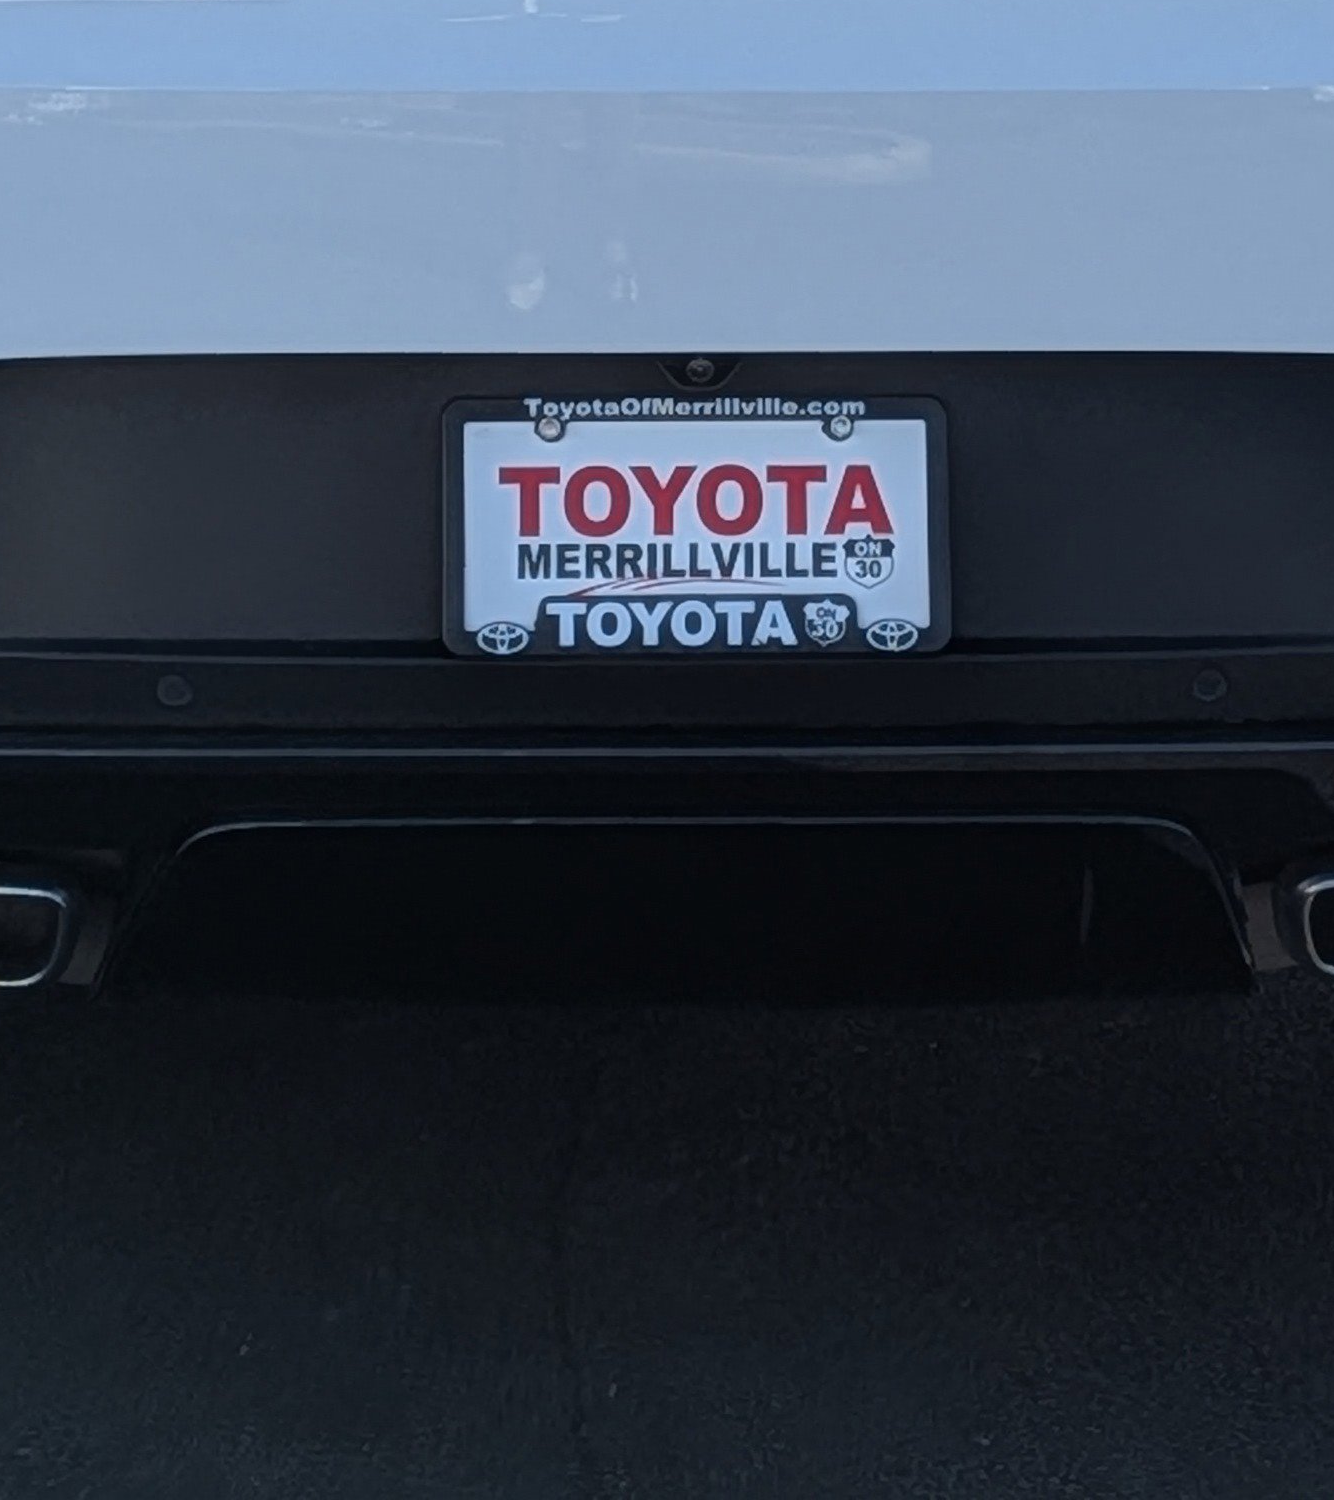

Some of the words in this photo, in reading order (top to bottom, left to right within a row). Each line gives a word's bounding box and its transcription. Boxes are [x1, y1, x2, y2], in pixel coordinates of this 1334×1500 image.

[523, 397, 866, 421] ToyotaOfMerrillville.com
[499, 464, 894, 536] TOYOTA
[517, 542, 838, 580] MERRILLVILLE
[854, 541, 882, 557] ON
[855, 560, 882, 578] 30
[545, 600, 799, 647] TOYOTA
